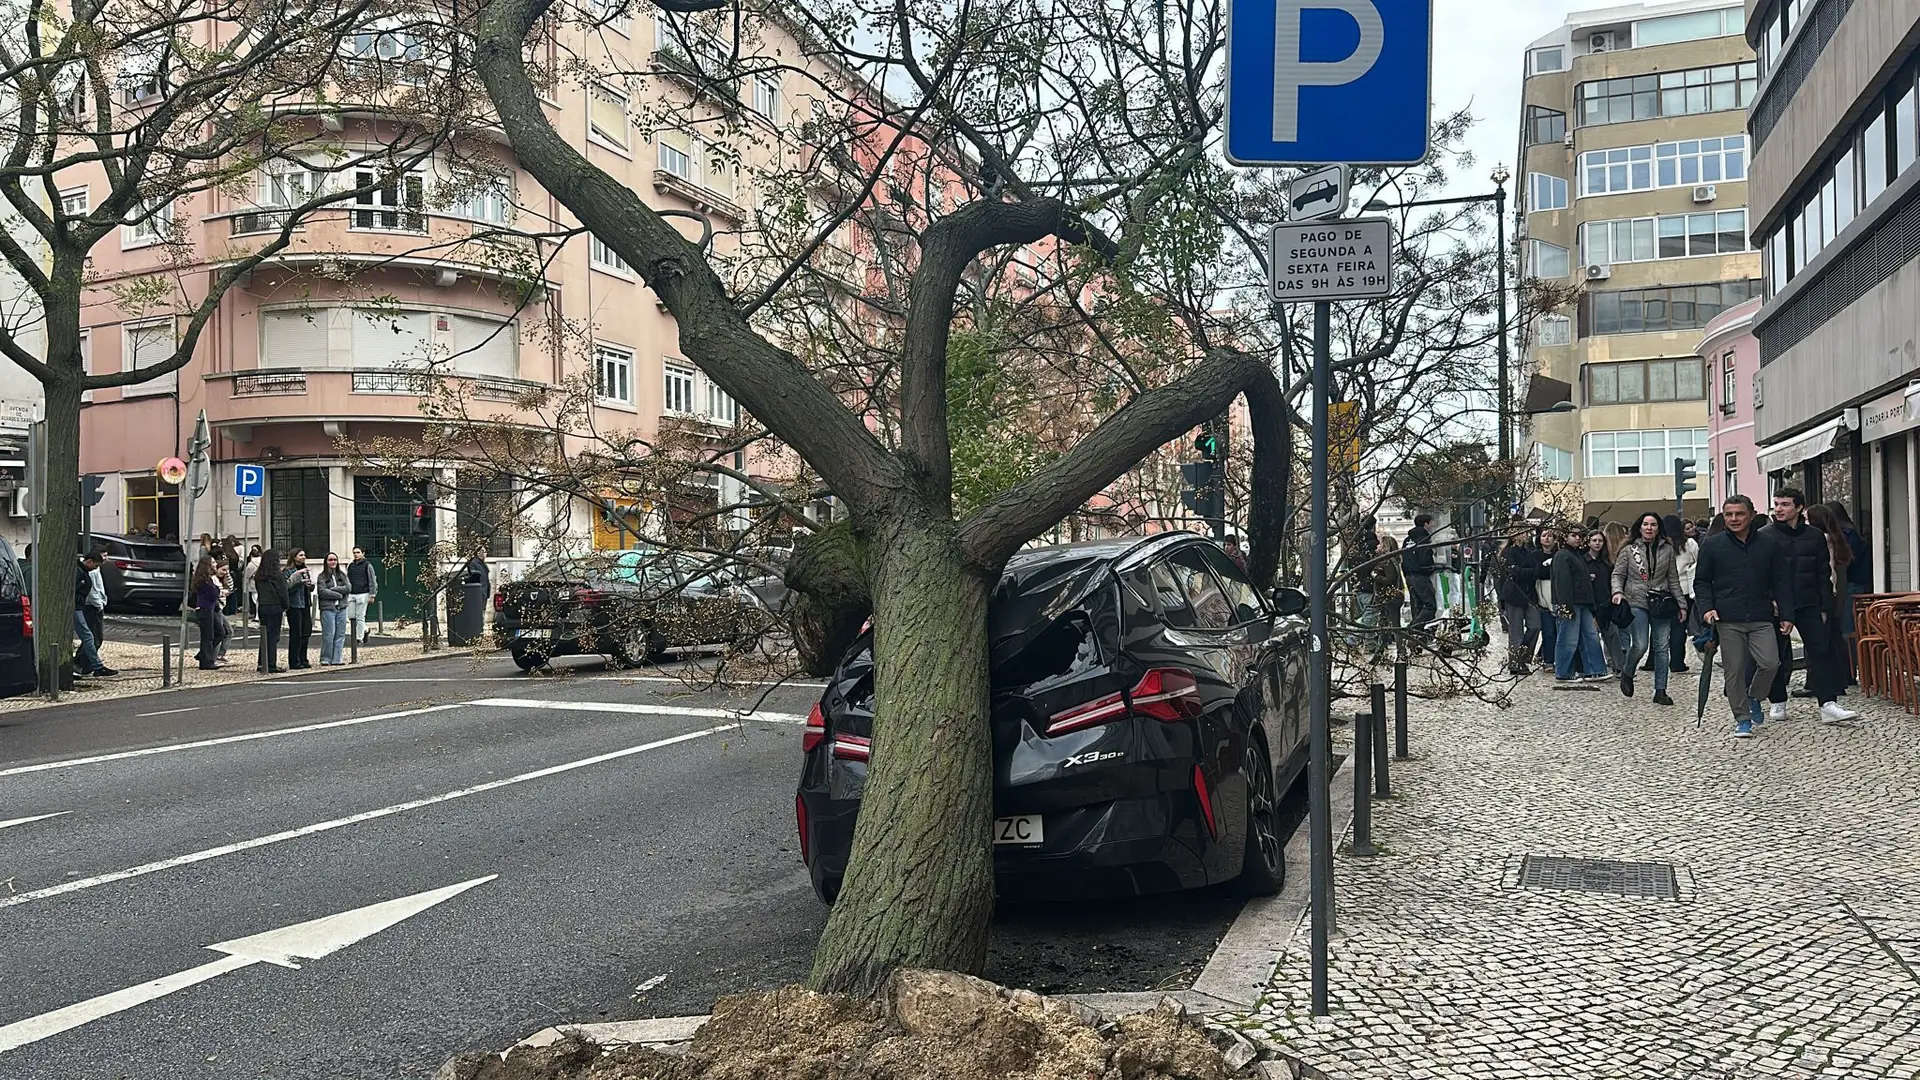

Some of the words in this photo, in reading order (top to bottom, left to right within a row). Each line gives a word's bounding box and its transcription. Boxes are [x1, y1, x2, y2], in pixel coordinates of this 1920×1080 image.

[1272, 0, 1385, 143] P
[1300, 231, 1337, 243] PAGO
[1345, 230, 1362, 240] DE
[1290, 246, 1357, 259] SEGUNDA
[1363, 245, 1373, 255] A
[1287, 263, 1329, 275] SEXTA
[1336, 260, 1376, 272] FEIRA
[1277, 280, 1304, 290] DAS
[1311, 278, 1329, 289] 9H
[1336, 275, 1355, 287] ÀS
[1362, 275, 1386, 286] 19H
[242, 469, 258, 493] P
